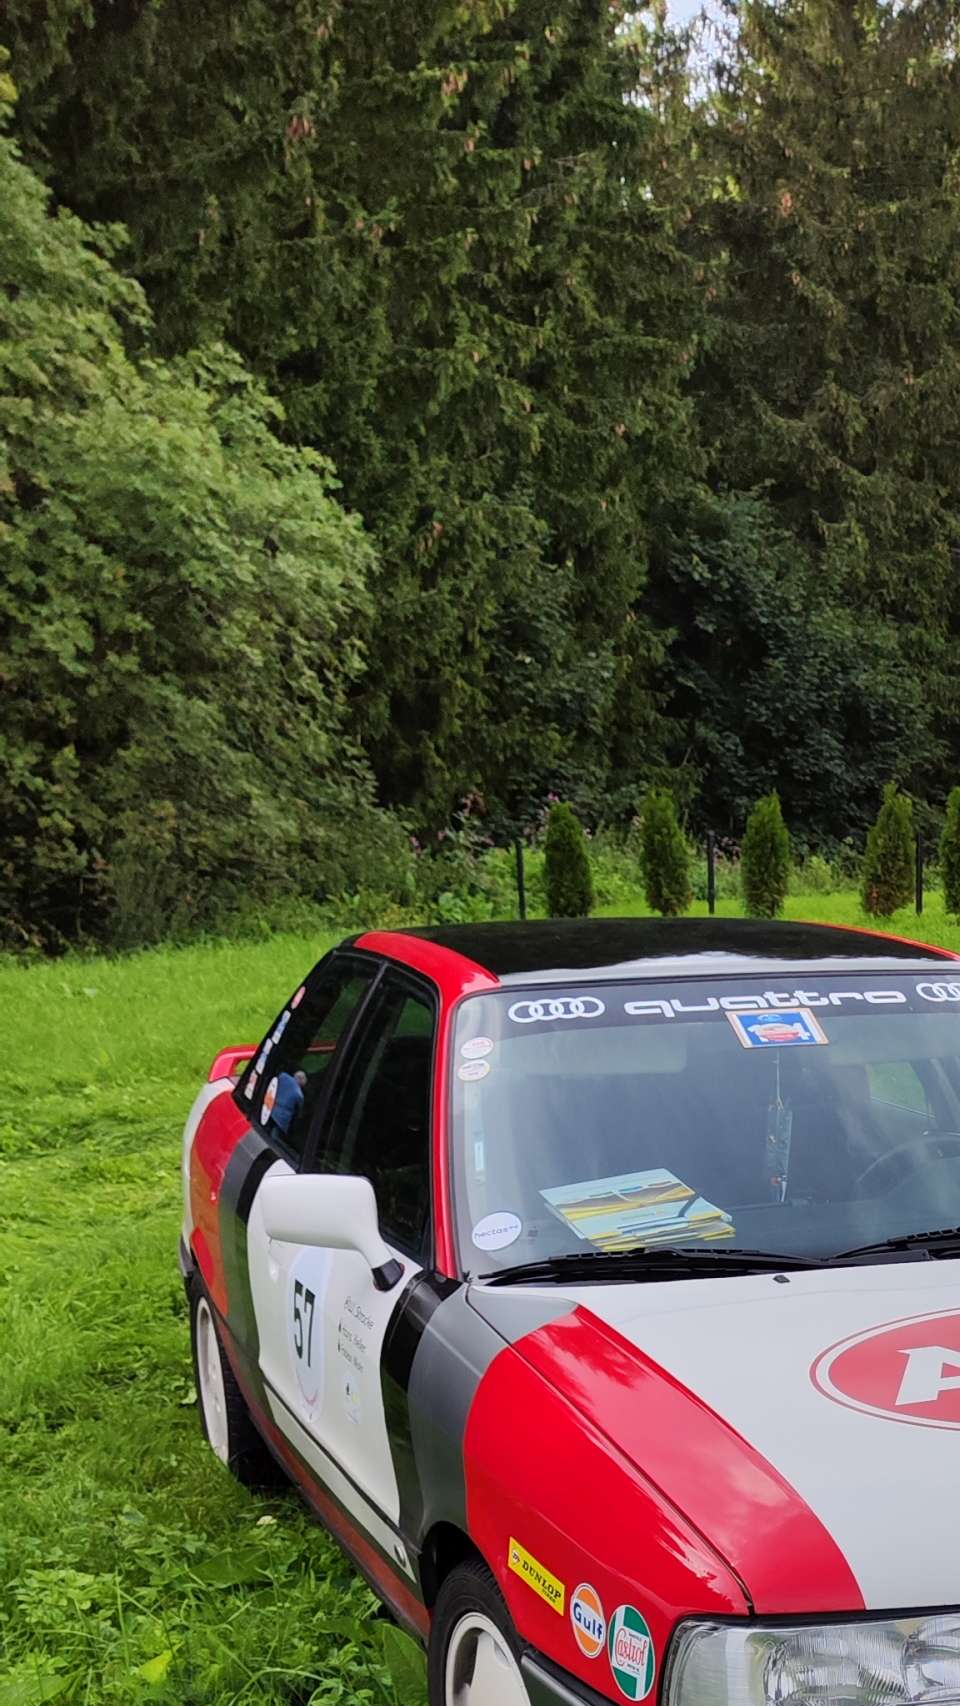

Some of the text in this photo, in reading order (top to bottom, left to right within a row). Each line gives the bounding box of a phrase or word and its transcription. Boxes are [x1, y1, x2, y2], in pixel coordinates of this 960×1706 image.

[624, 988, 906, 1018] quattro
[292, 1279, 316, 1368] 57
[522, 1559, 562, 1600] DUNLOP
[573, 1602, 603, 1640] Gulf
[615, 1627, 648, 1667] Castrol
